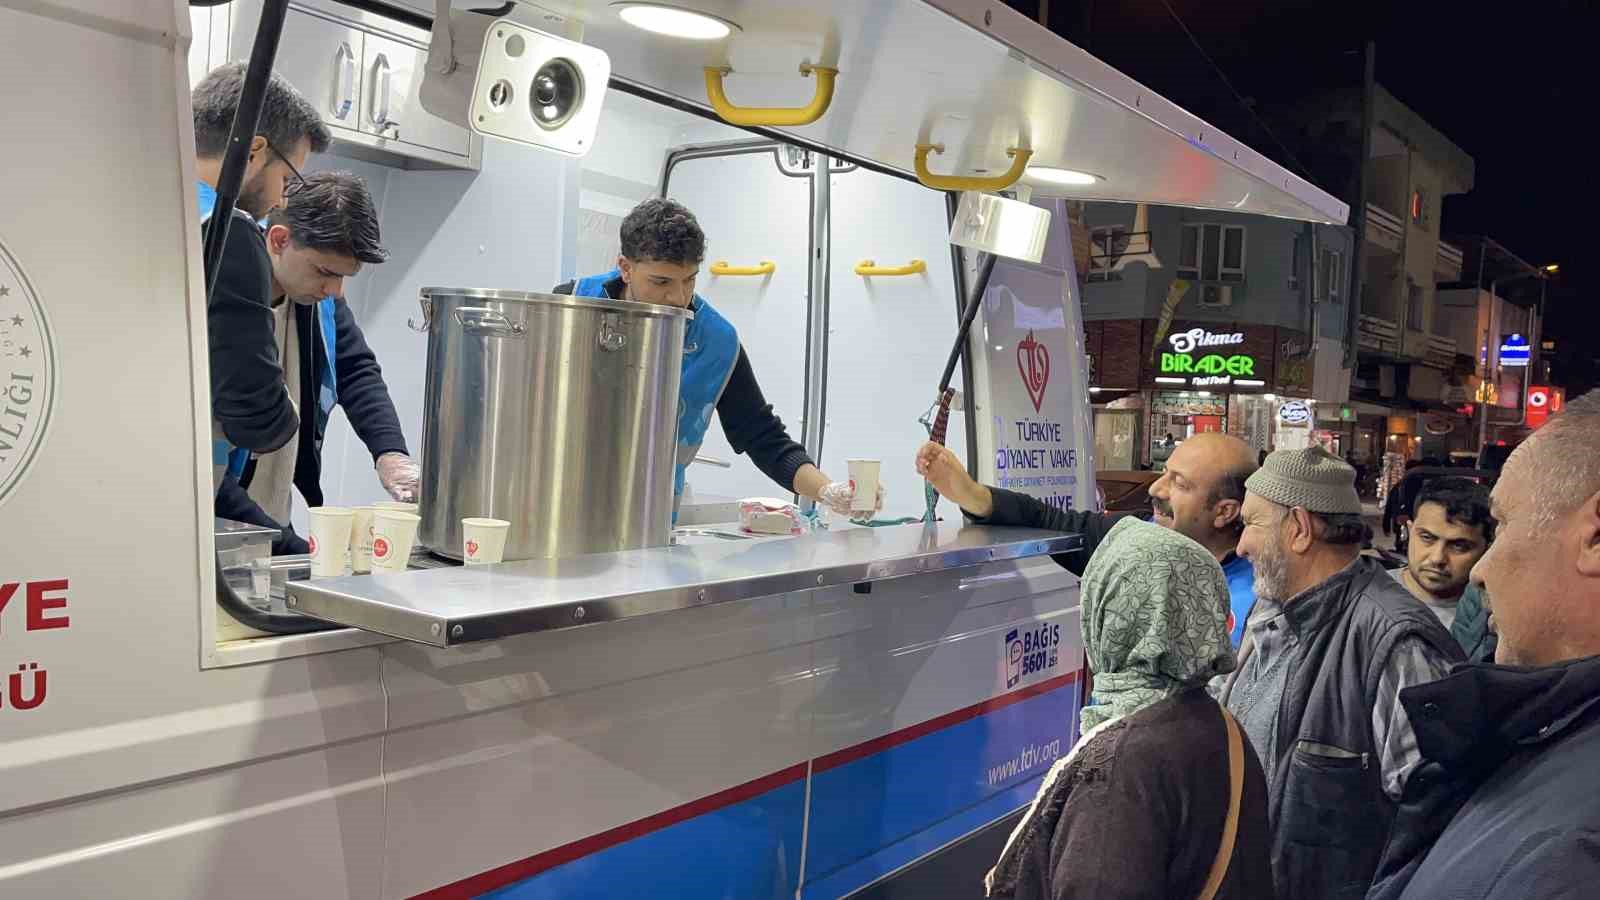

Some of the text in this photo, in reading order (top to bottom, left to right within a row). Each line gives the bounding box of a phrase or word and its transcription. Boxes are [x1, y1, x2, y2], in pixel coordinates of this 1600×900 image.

[1016, 418, 1061, 442] TÜRKİYE
[997, 445, 1045, 469] DİYANET
[1024, 623, 1059, 653] BAĞIŞ
[1022, 651, 1046, 675] 5601
[988, 738, 1060, 785] www.tdv.org
